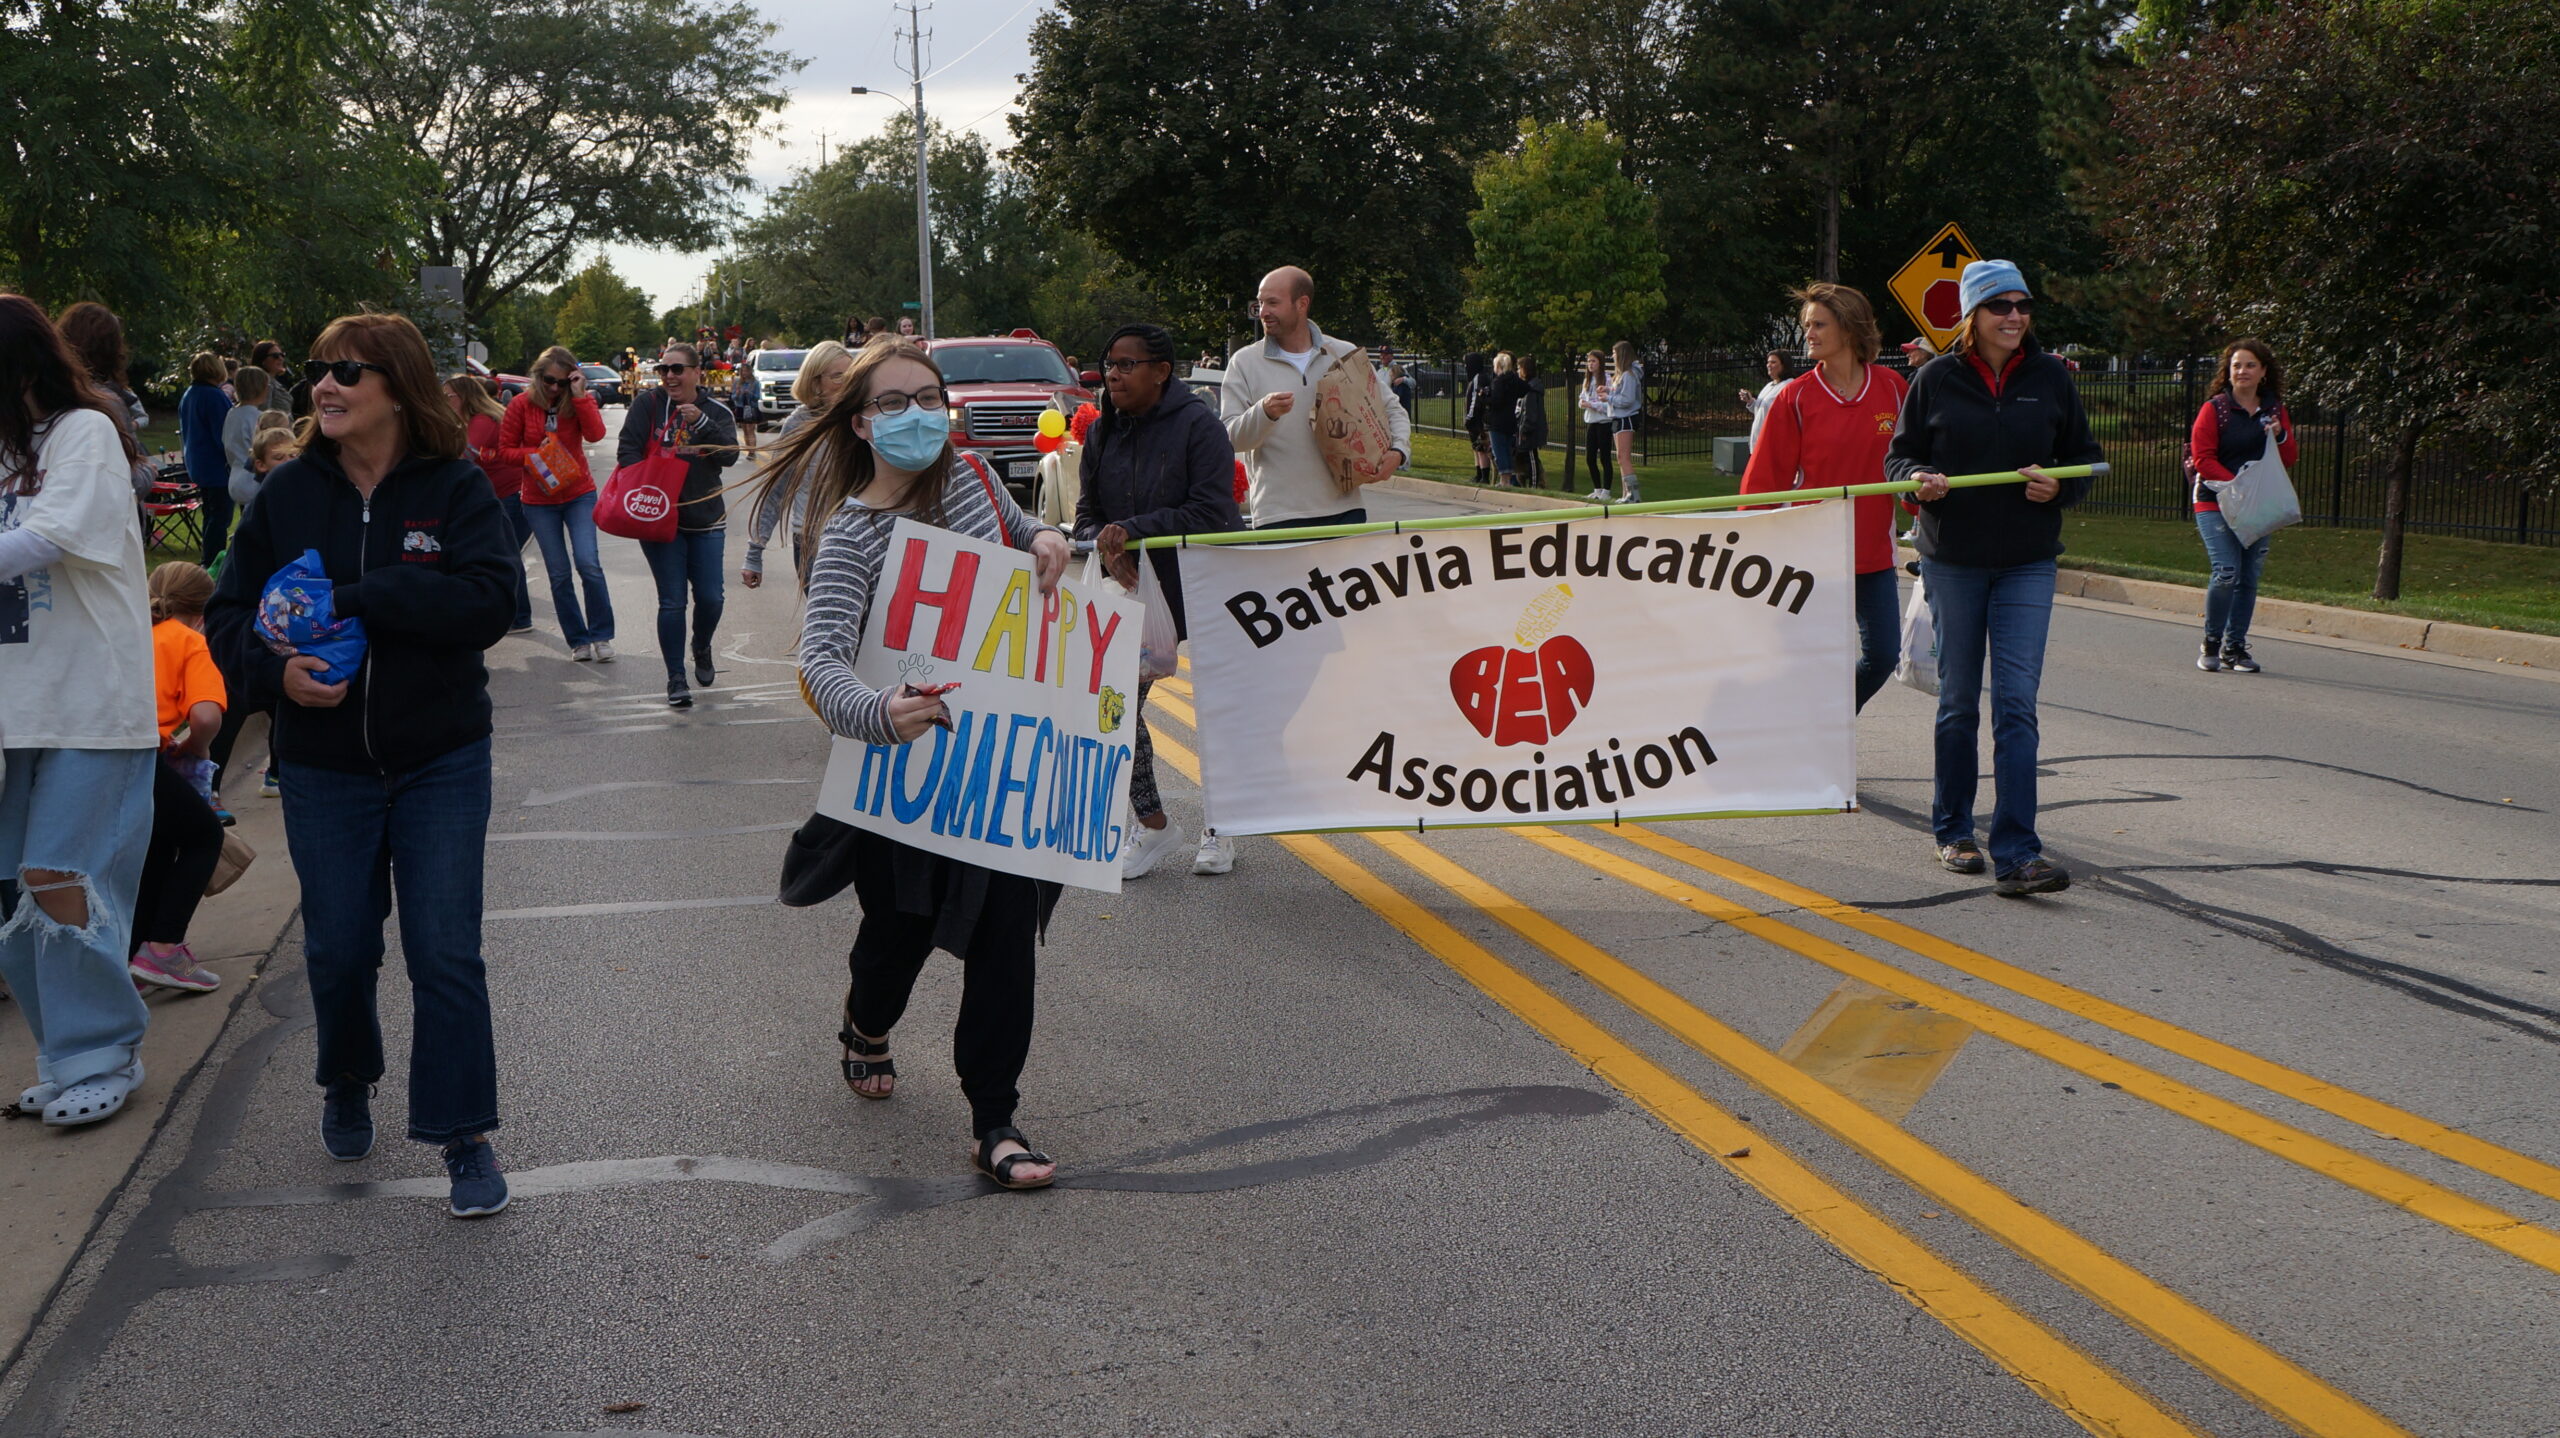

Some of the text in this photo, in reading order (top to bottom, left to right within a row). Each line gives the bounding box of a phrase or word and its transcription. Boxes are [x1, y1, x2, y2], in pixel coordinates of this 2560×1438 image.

[631, 492, 663, 505] Jewel
[883, 538, 1122, 694] HAPPY
[1225, 522, 1815, 648] Batavia Education
[1516, 586, 1559, 635] EDUCATING
[1526, 595, 1570, 642] TOGETHER
[1450, 635, 1595, 747] BEA
[853, 710, 1132, 863] HOMECOMING
[1346, 727, 1718, 814] Association
